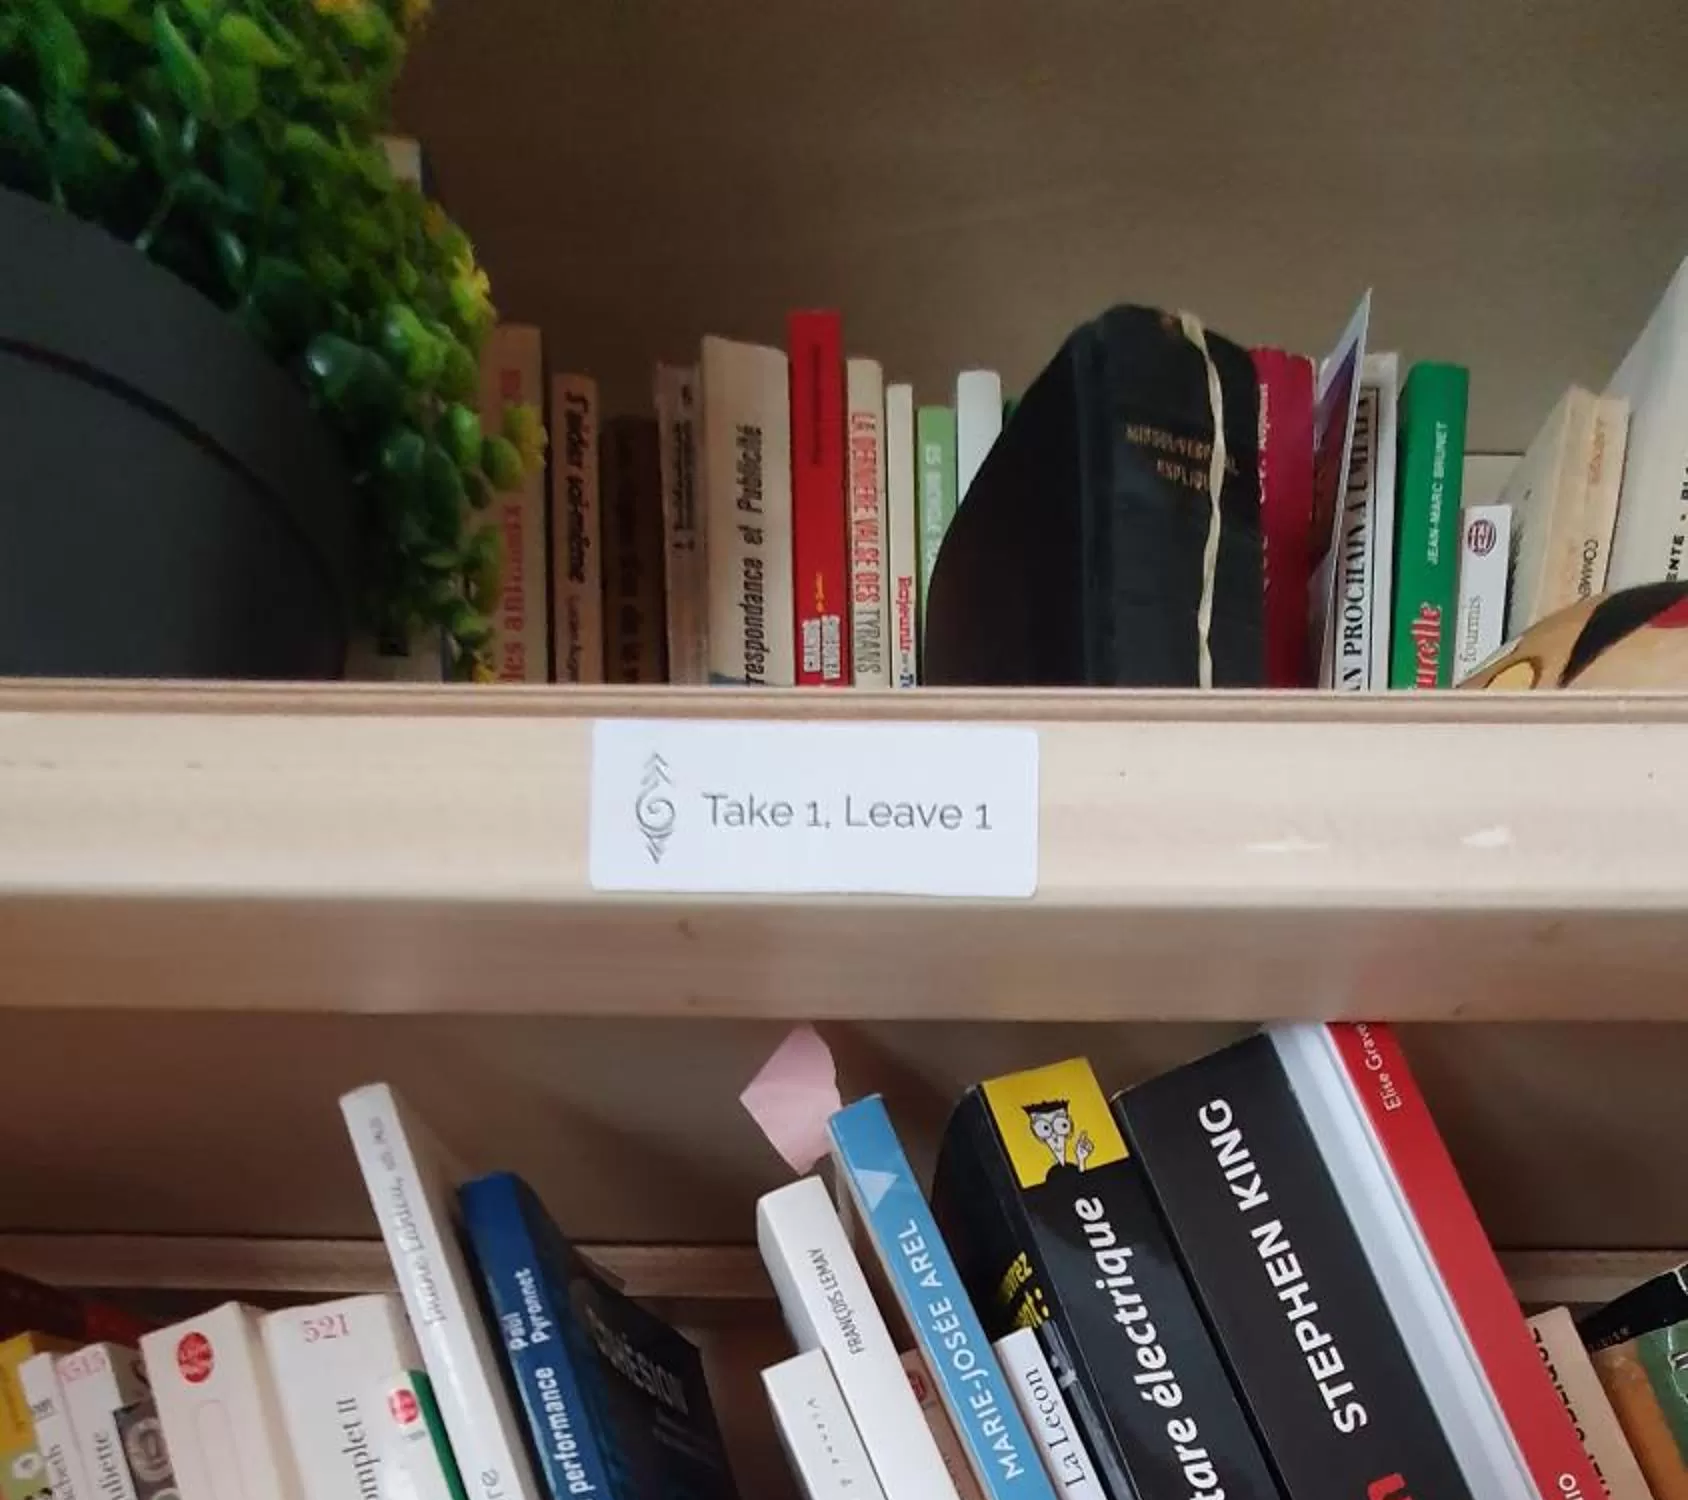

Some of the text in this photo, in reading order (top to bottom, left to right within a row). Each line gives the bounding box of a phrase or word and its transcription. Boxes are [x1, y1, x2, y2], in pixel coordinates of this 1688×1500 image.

[1425, 420, 1448, 564] JEAN-MARC BRUNET
[746, 524, 764, 546] et
[854, 572, 880, 602] DES
[1340, 525, 1368, 656] PROCHAIN
[855, 608, 881, 673] TYRANS
[700, 793, 992, 830] Take 1, Leave 1
[1349, 1020, 1385, 1073] Grave
[805, 1244, 869, 1356] FRANÇOIS LEMAY
[1076, 1196, 1184, 1407] électrique
[1199, 1099, 1368, 1433] STEPHEN KING
[302, 1312, 351, 1343] 521
[501, 1310, 530, 1351] Paul
[897, 1219, 1024, 1480] MARIE-JOSÉE AREL
[535, 1366, 592, 1494] performance
[1021, 1365, 1070, 1450] Leçon
[1055, 1451, 1087, 1488] La
